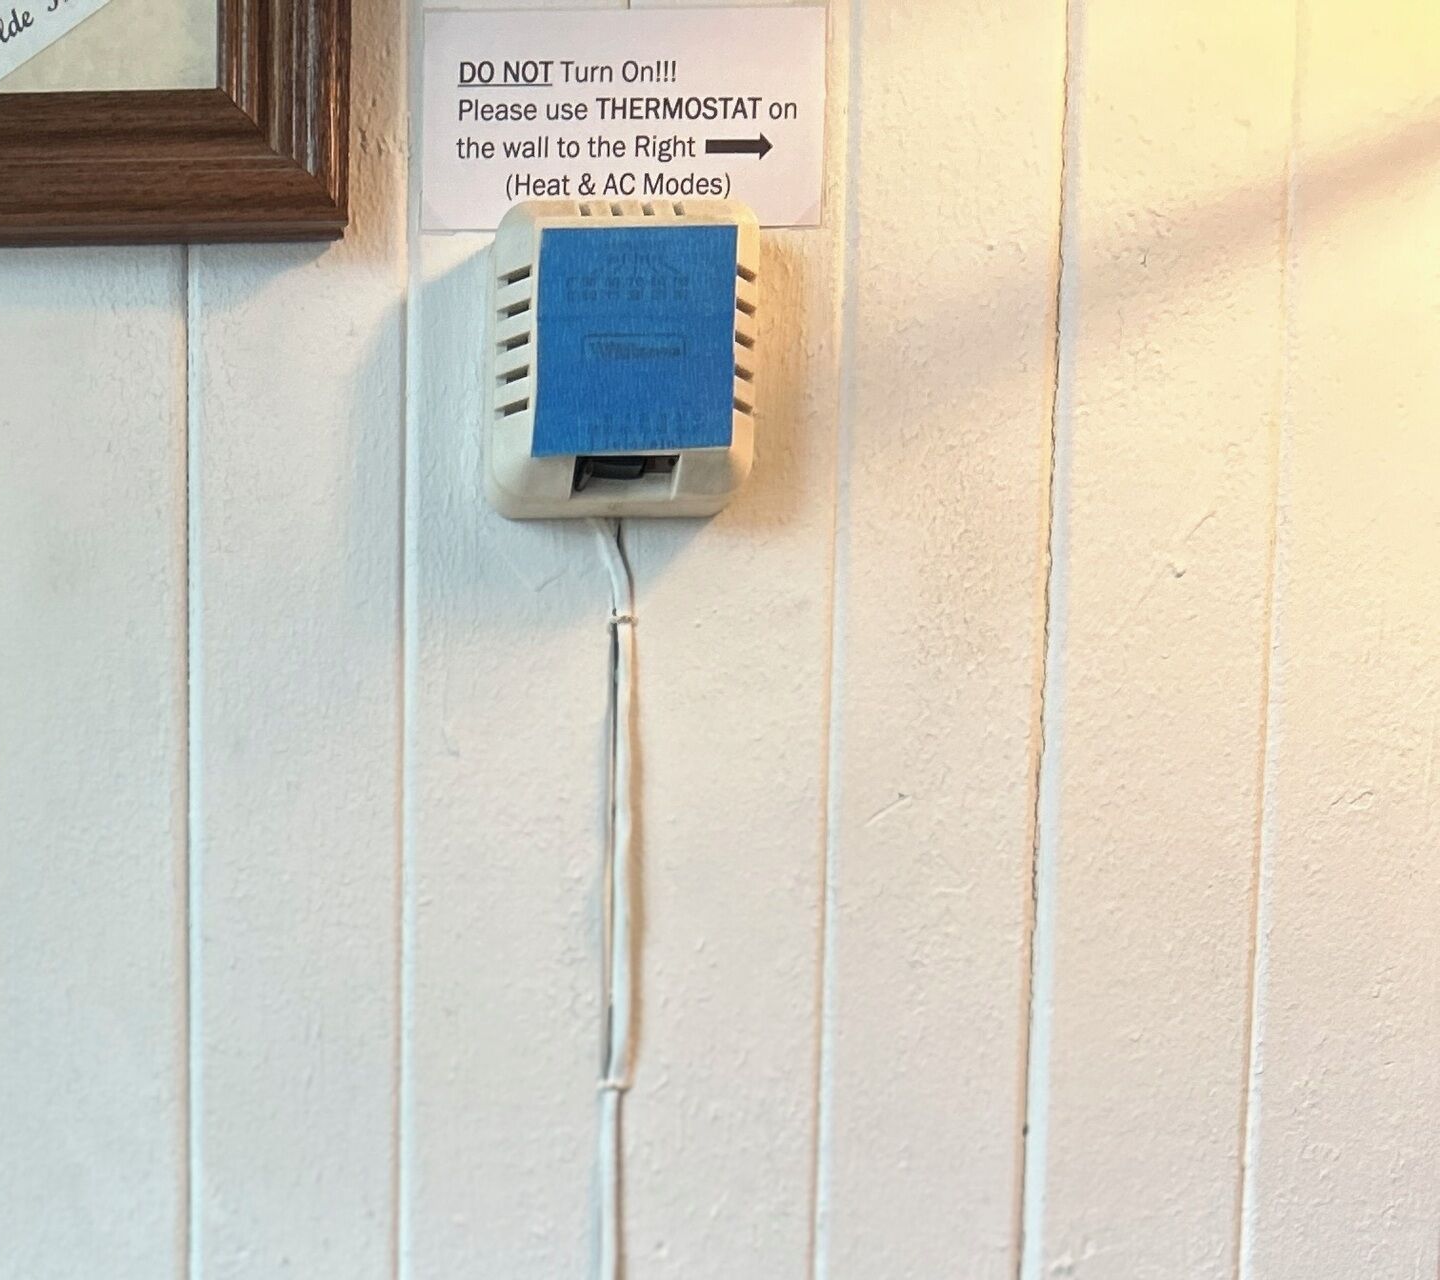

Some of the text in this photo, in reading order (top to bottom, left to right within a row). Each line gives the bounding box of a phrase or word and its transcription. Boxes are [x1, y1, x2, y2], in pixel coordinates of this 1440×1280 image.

[458, 61, 677, 83] DO NOT Turn On!!!
[458, 97, 797, 122] Please use THERMOSTAT on
[457, 135, 695, 162] the wall to the Right
[505, 172, 732, 201] (Heat & AC Modes)
